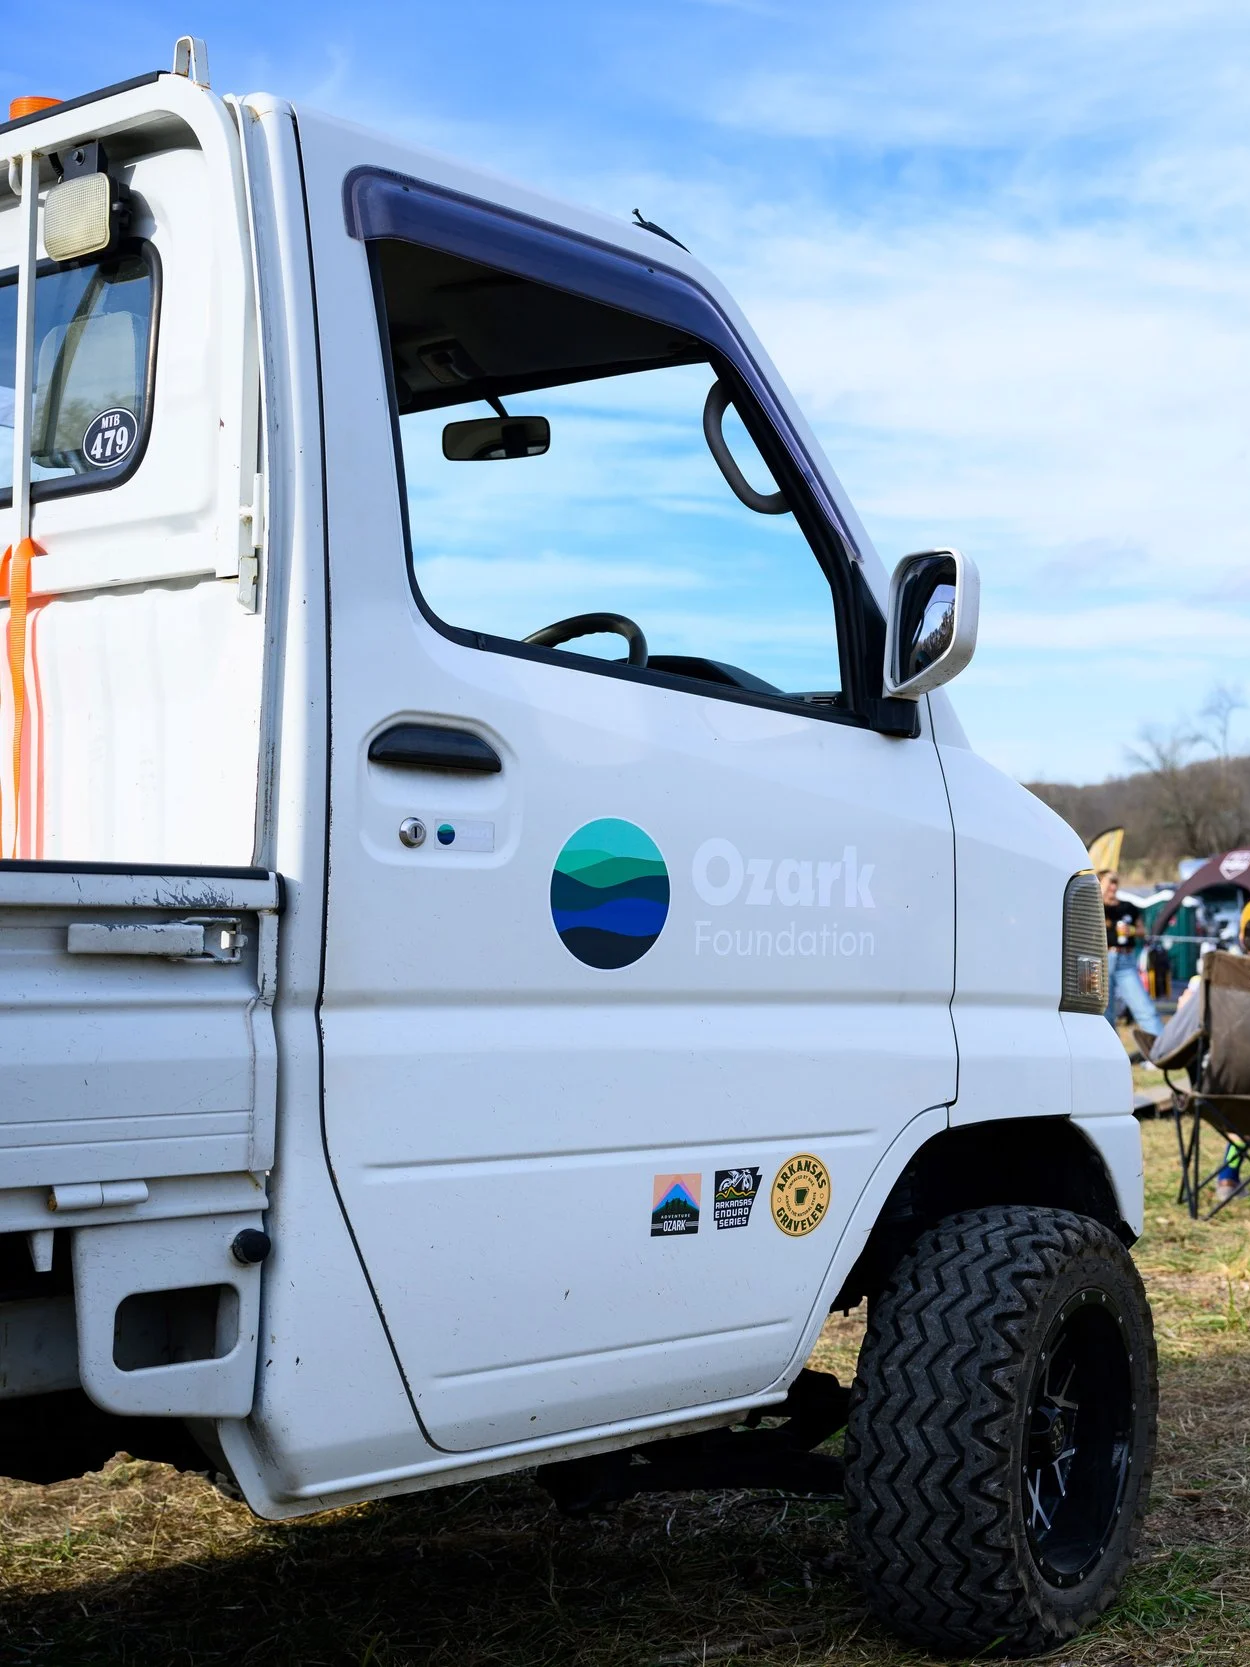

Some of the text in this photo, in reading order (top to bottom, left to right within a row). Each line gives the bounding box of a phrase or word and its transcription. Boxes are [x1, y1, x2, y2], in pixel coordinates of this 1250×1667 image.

[101, 414, 120, 429] MTB
[90, 426, 129, 459] 479
[691, 837, 876, 908] Ozark
[694, 920, 875, 957] Foundation
[777, 1160, 827, 1192] ARKANSAS
[714, 1207, 749, 1219] ENDURO
[715, 1198, 753, 1210] ARKANSAS
[663, 1219, 687, 1232] OZARK
[718, 1216, 747, 1228] SERIES
[776, 1203, 825, 1232] GRAVELER
